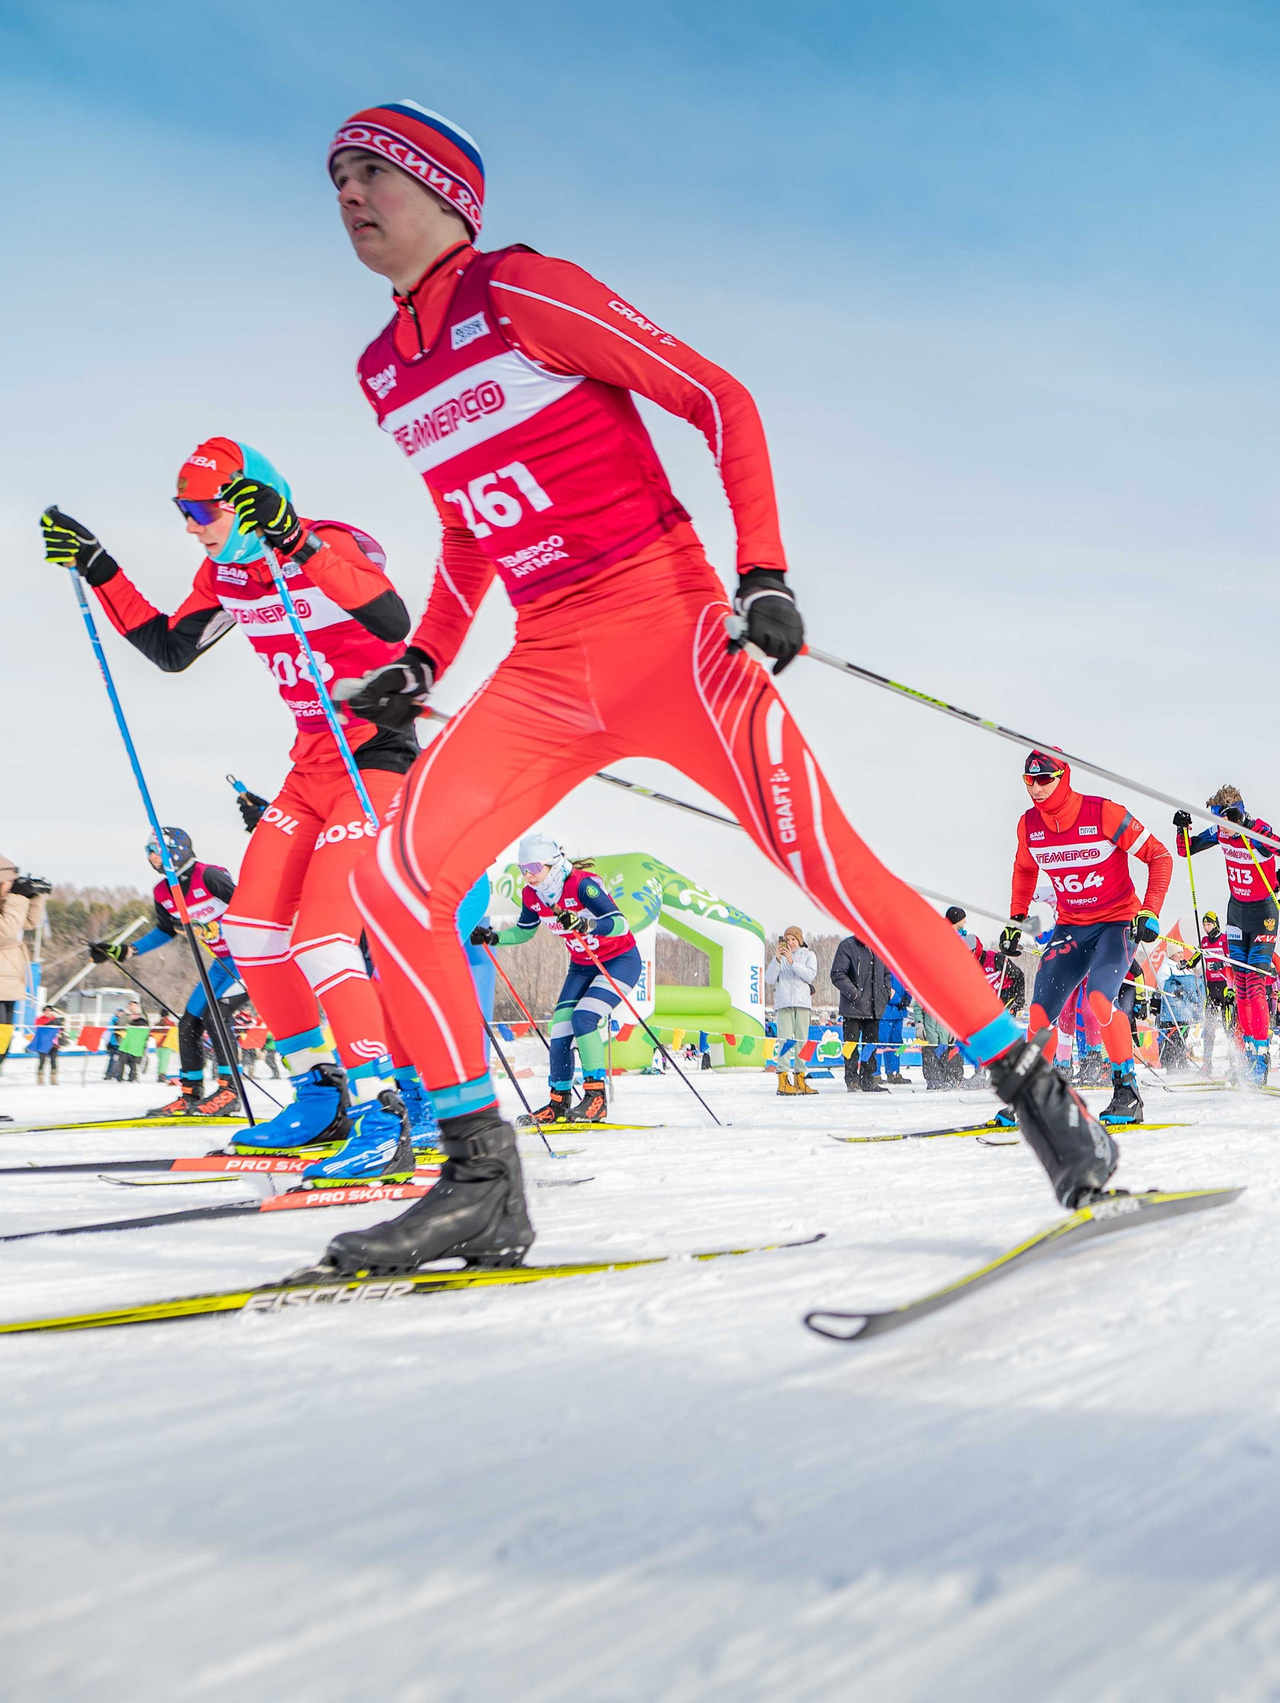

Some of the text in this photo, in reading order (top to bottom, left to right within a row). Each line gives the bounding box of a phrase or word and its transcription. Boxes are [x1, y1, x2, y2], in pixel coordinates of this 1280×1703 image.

[607, 299, 666, 337] CRAFT
[442, 460, 554, 539] 261
[216, 565, 249, 580] БАМ
[510, 550, 570, 578] АНГАРА
[225, 598, 312, 625] ТЕМЕРО
[771, 784, 798, 844] CRAFT
[1035, 848, 1101, 864] ТЕМЕРСО
[1050, 871, 1105, 893] 364
[1228, 866, 1254, 885] 313
[750, 965, 759, 1004] БАМ
[225, 1159, 259, 1171] PRO
[305, 1187, 404, 1205] PRO SKATE
[243, 1281, 416, 1313] FISCHER
